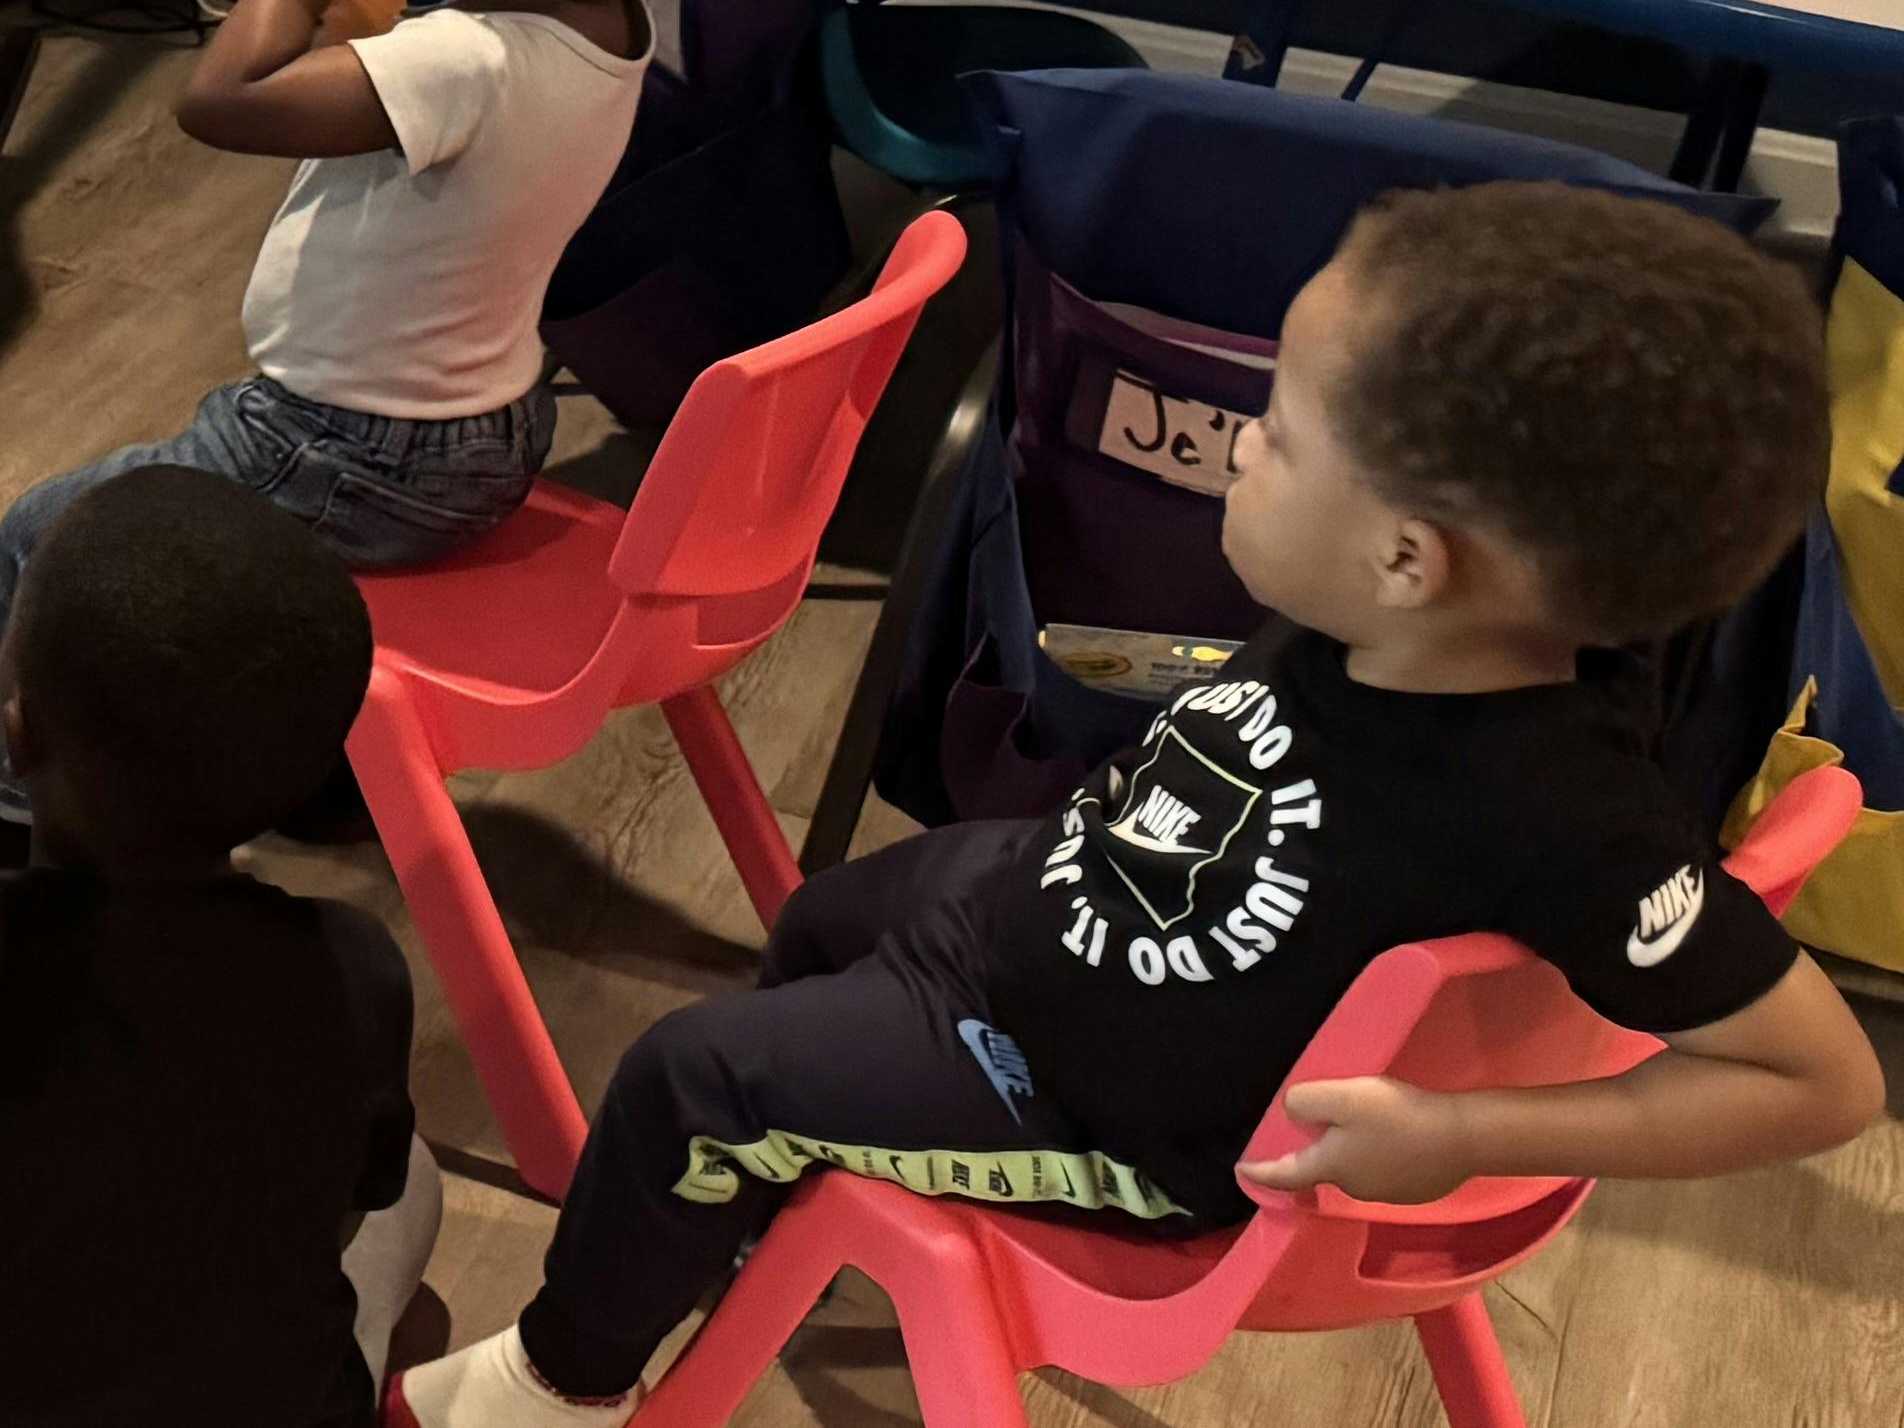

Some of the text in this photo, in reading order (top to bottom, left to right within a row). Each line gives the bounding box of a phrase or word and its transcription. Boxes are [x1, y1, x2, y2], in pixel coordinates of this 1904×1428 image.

[1238, 694, 1293, 771] DO
[1137, 784, 1202, 844] NIKE
[1208, 856, 1310, 973] JUST
[1638, 863, 1696, 939] NIKE
[1128, 935, 1216, 986] DO
[985, 1031, 1035, 1098] NIKE
